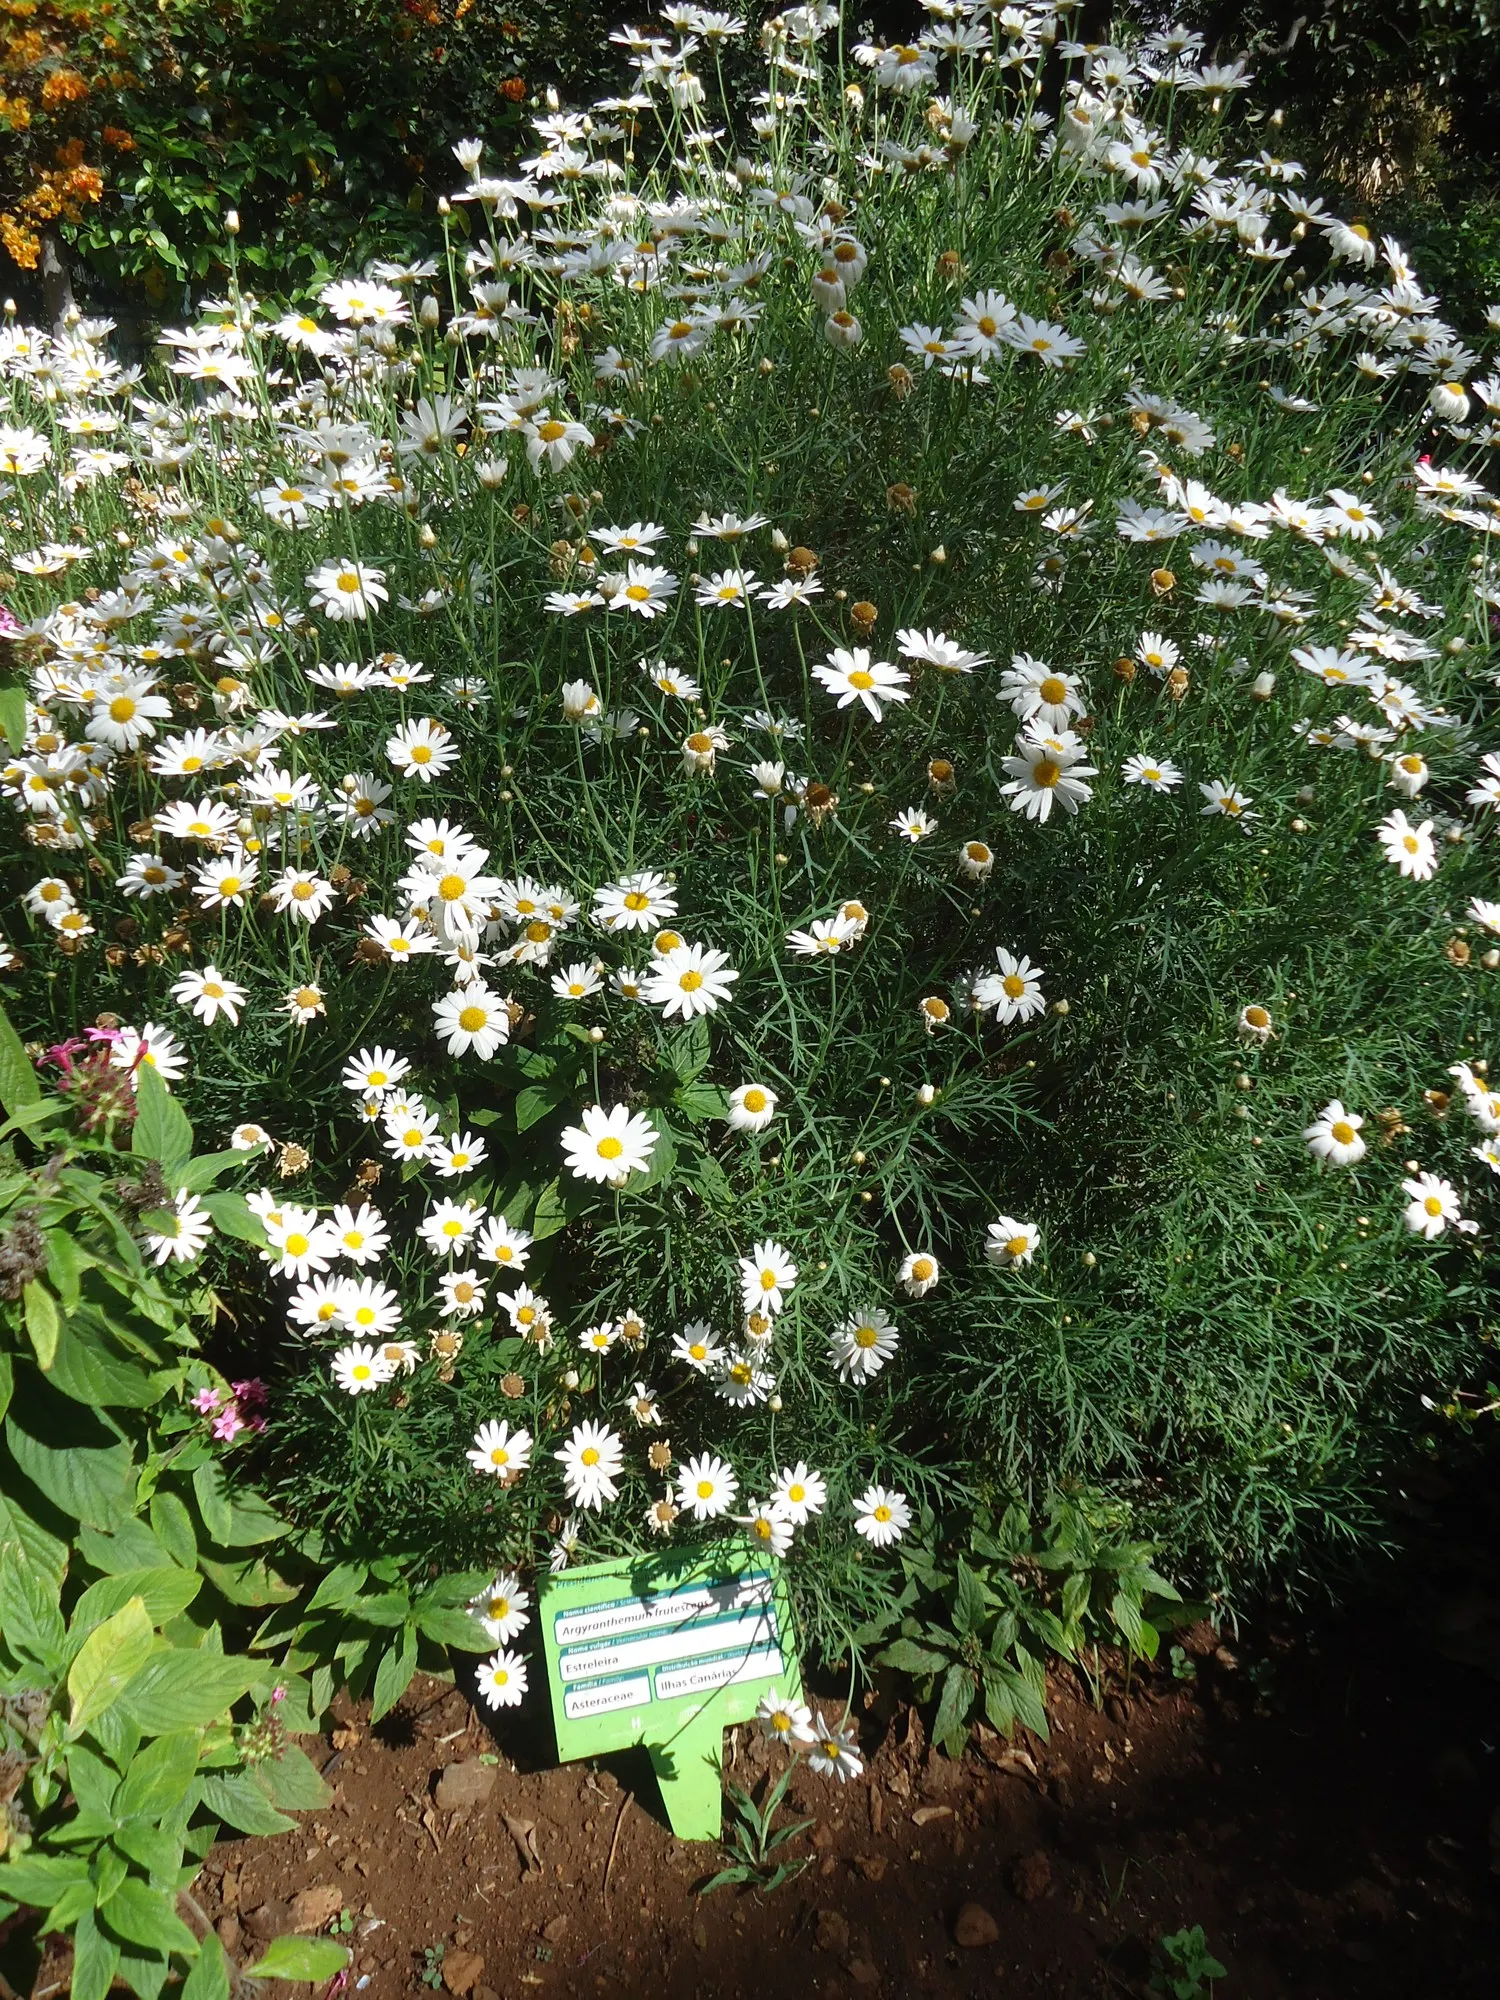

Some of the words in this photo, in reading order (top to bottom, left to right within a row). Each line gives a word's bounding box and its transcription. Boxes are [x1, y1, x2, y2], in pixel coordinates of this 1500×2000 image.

[563, 1608, 583, 1618] Nome
[562, 1611, 651, 1636] Argyranthemum
[568, 1644, 588, 1654] Nome
[589, 1640, 610, 1651] vulgar
[566, 1656, 619, 1673] Estreleira
[661, 1679, 687, 1691] Ilhas
[690, 1669, 737, 1685] Canárias
[571, 1691, 634, 1711] Asteraceae
